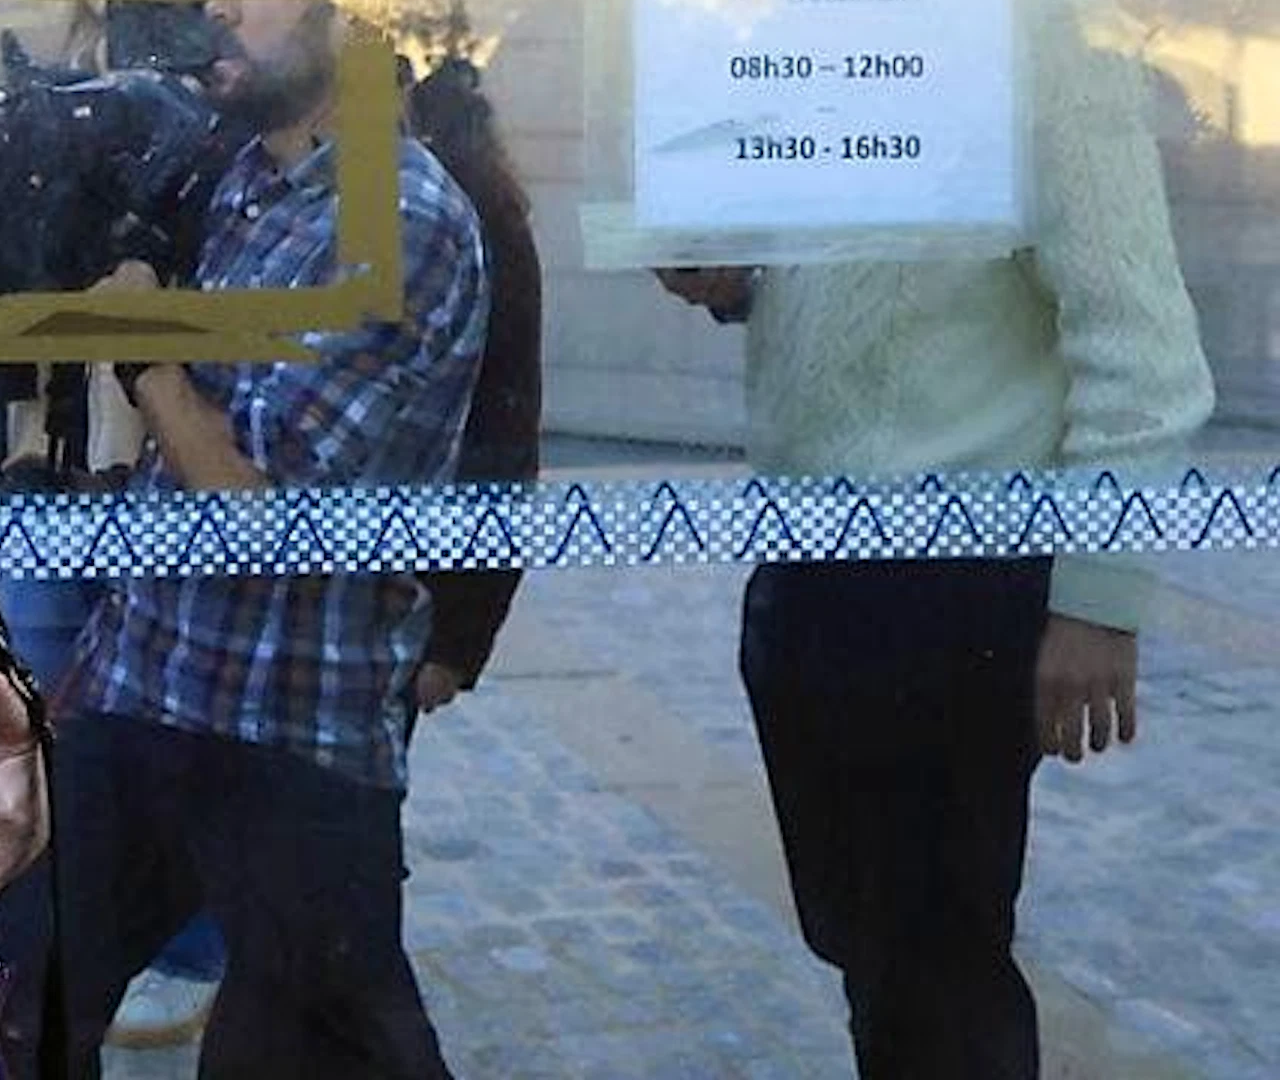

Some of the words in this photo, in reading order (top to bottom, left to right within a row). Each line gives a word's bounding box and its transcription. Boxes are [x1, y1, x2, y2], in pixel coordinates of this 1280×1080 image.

[730, 54, 813, 79] 08h30
[844, 54, 924, 79] 12h00
[735, 134, 816, 160] 13h30
[841, 134, 921, 160] 16h30
